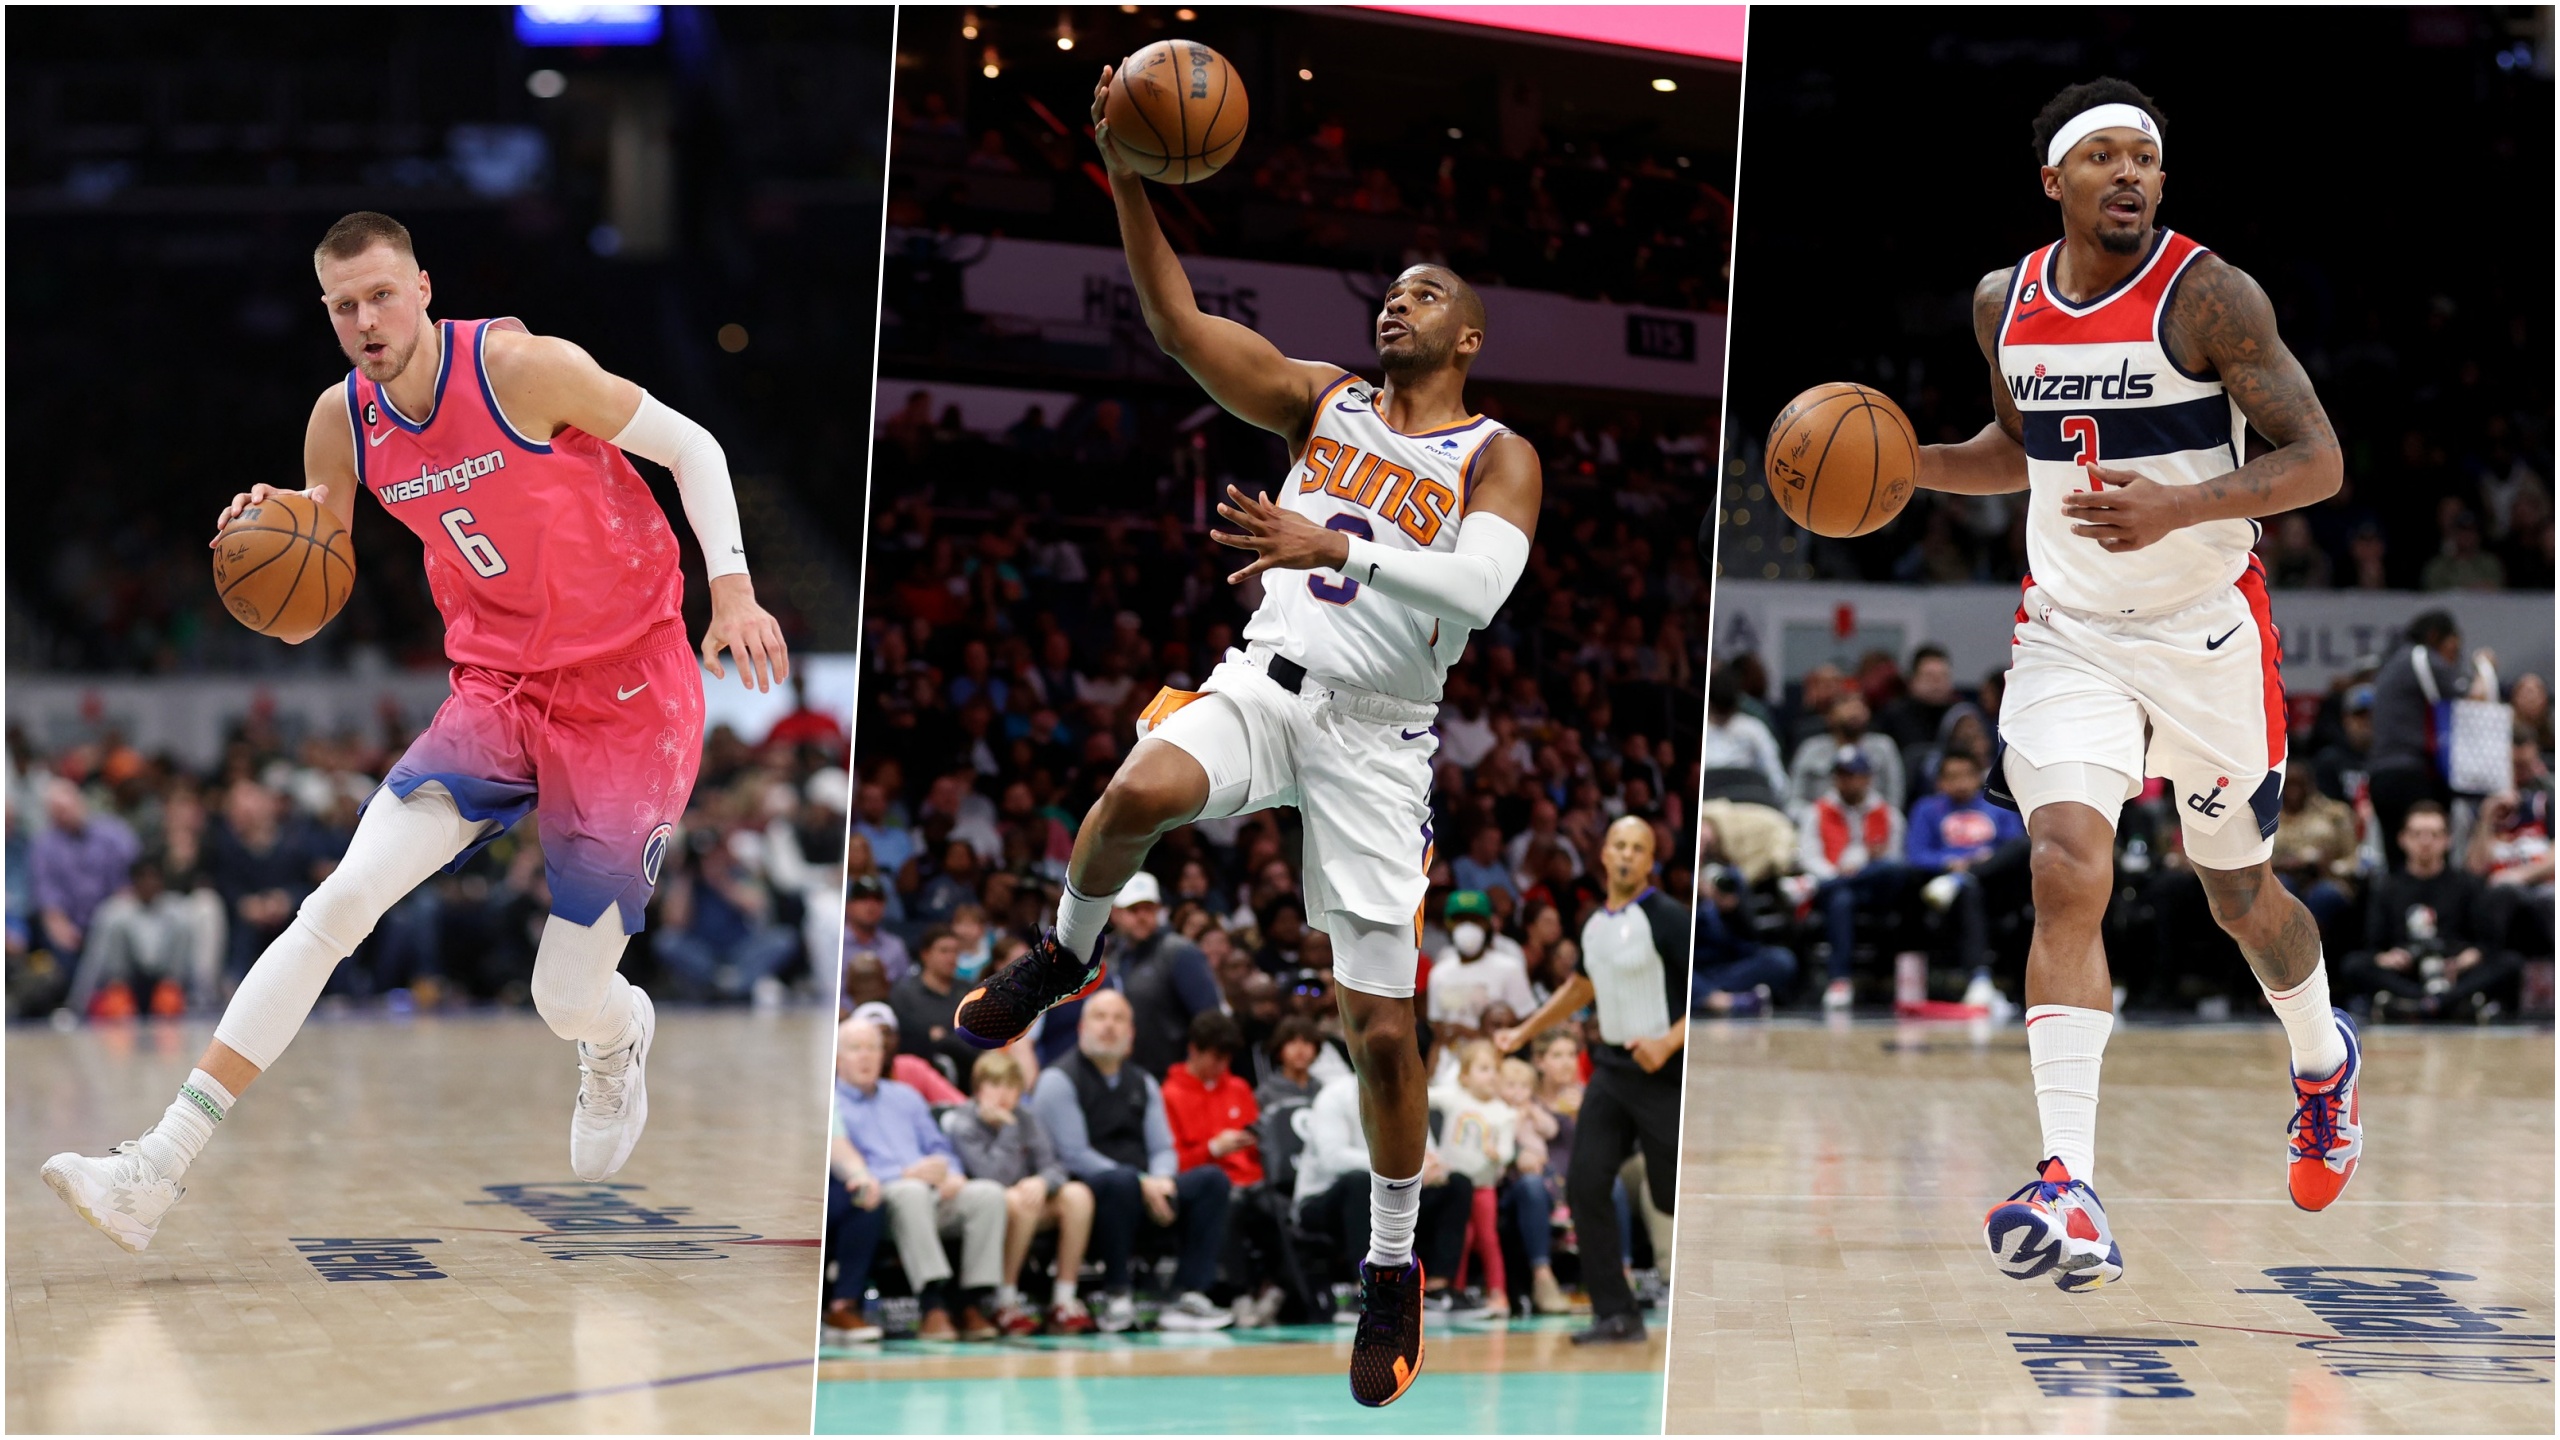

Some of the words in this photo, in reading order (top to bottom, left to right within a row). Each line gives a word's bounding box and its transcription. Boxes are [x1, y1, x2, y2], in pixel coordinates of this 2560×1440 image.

[2022, 282, 2038, 302] 6
[2008, 358, 2157, 401] wizards
[368, 404, 377, 423] 6
[1424, 444, 1461, 461] PayPal
[378, 449, 506, 505] washington
[439, 507, 508, 579] 6
[288, 1236, 449, 1282] Arena
[2005, 1331, 2200, 1399] Arena
